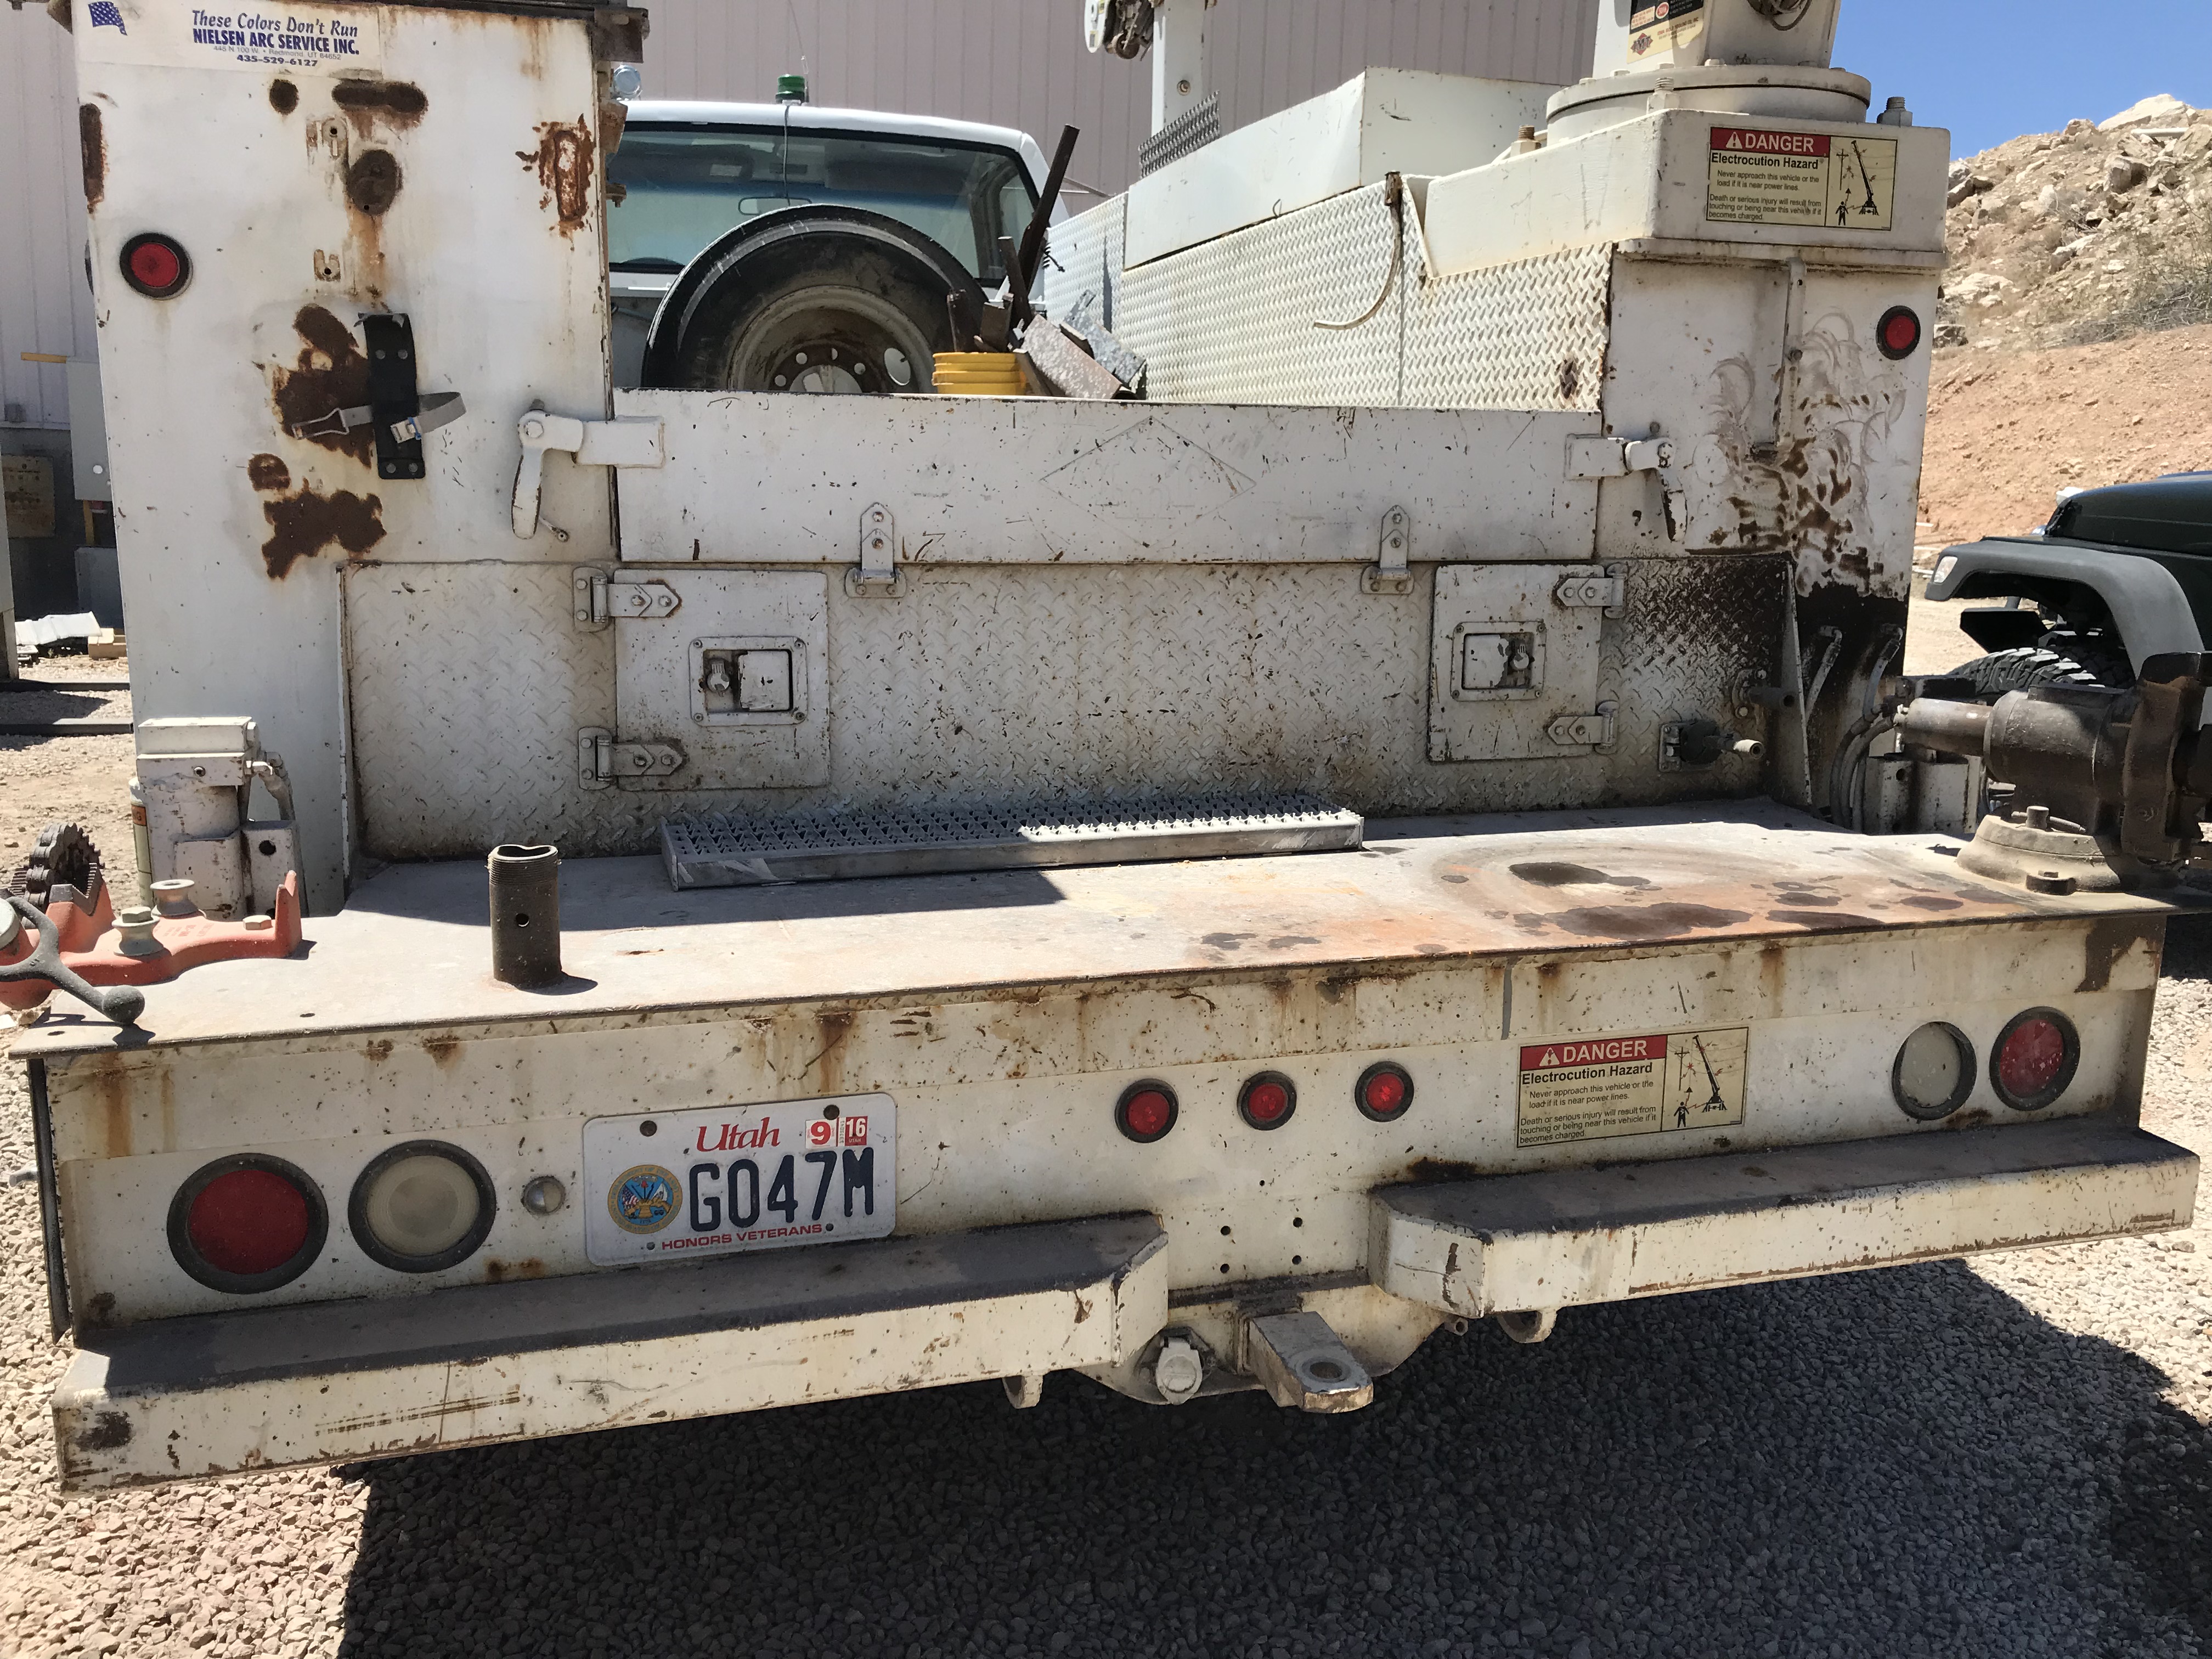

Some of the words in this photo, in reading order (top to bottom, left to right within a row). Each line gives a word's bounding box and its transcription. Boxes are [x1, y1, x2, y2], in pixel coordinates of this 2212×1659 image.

[193, 9, 232, 27] These
[238, 13, 281, 31] Colors
[286, 16, 325, 35] Don't
[330, 20, 358, 37] Run
[193, 29, 245, 46] NIELSEN
[250, 32, 275, 48] ARC
[278, 33, 330, 52] SERVICE
[334, 38, 359, 55] INC.
[237, 54, 318, 67] 435-529-6127
[269, 48, 303, 57] Redmond
[1745, 133, 1814, 153] DANGER
[1711, 153, 1780, 167] Electrocution
[1784, 157, 1819, 170] Hazard
[1709, 203, 1735, 212] touching
[1745, 204, 1761, 213] being
[1761, 197, 1778, 206] injury
[1563, 1040, 1647, 1063] DANGER
[1522, 1068, 1605, 1085] Electrocution
[1610, 1062, 1652, 1076] Hazard
[1554, 1086, 1588, 1098] approach
[1605, 1082, 1630, 1091] vehicle
[1642, 1080, 1654, 1088] the
[1529, 1100, 1545, 1109] load
[1586, 1095, 1609, 1104] power
[1520, 1125, 1551, 1135] touching
[1562, 1121, 1583, 1130] being
[1618, 1115, 1644, 1124] vehicle
[1521, 1117, 1543, 1126] Death
[1554, 1114, 1581, 1122] serious
[1583, 1111, 1602, 1120] injury
[1604, 1109, 1616, 1117] will
[1618, 1107, 1638, 1115] result
[696, 1116, 781, 1152] Utah
[810, 1121, 831, 1145] 9
[846, 1118, 866, 1137] 16
[1520, 1134, 1553, 1143] becomes
[1555, 1130, 1587, 1139] charged.
[662, 1233, 732, 1250] HONORS
[736, 1223, 823, 1242] VETERANS
